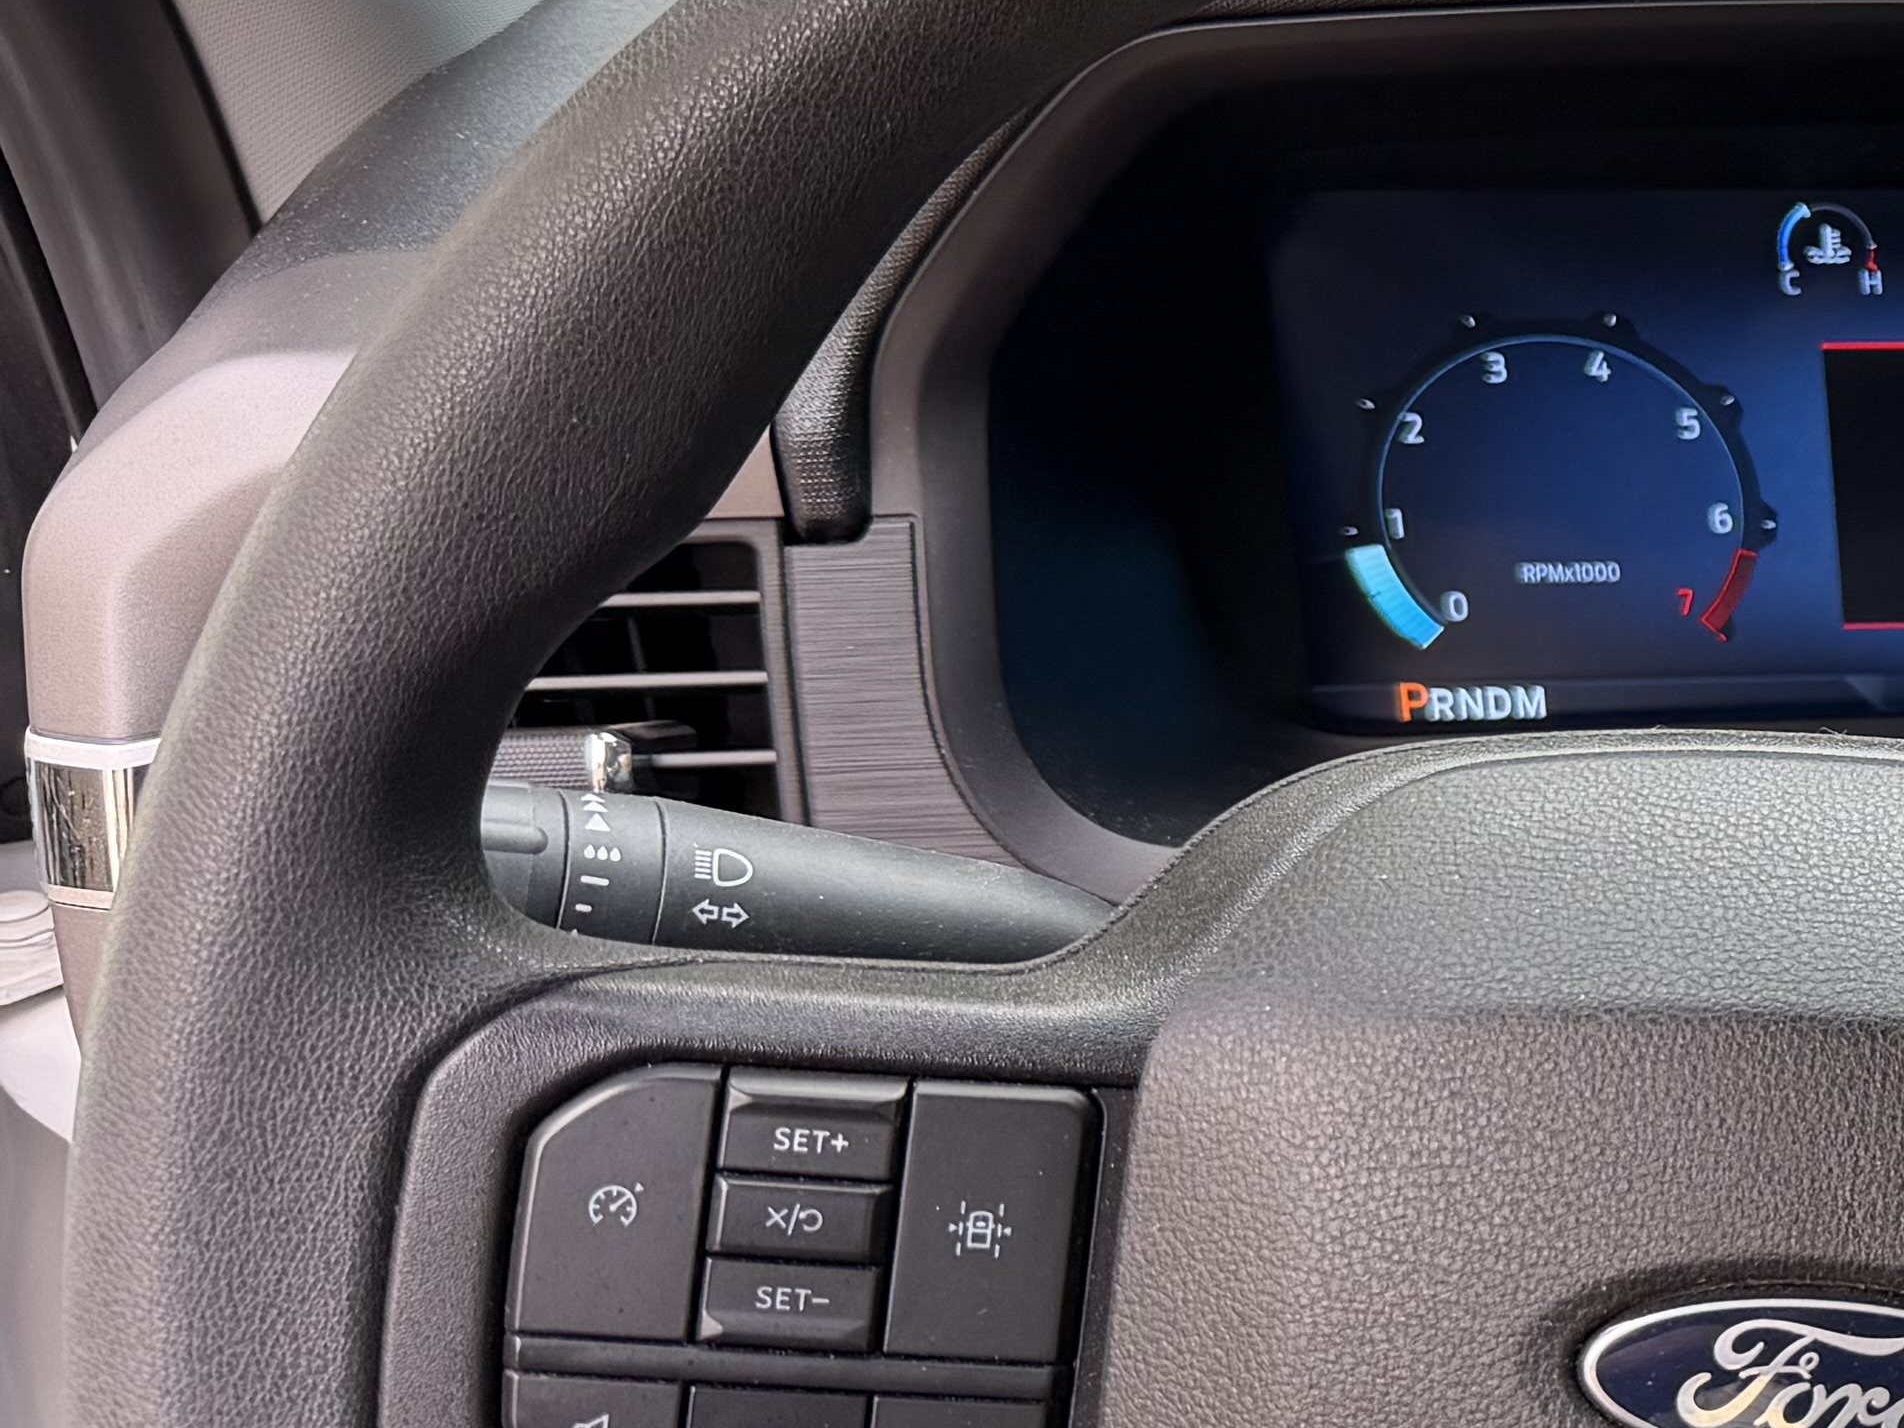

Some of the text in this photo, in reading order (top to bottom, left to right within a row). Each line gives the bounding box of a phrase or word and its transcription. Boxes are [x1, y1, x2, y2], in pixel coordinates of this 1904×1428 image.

[1778, 270, 1801, 296] C
[1859, 270, 1883, 296] H
[1481, 351, 1508, 384] 3
[1583, 350, 1612, 383] 4
[1401, 412, 1425, 446] 2
[1676, 408, 1701, 441] 5
[1384, 508, 1405, 539] 1
[1706, 502, 1734, 535] 6
[1517, 560, 1621, 585] RPMx1000
[1440, 591, 1469, 624] 0
[1675, 588, 1694, 617] 7
[773, 1127, 850, 1154] SET+
[755, 1286, 830, 1312] SET-
